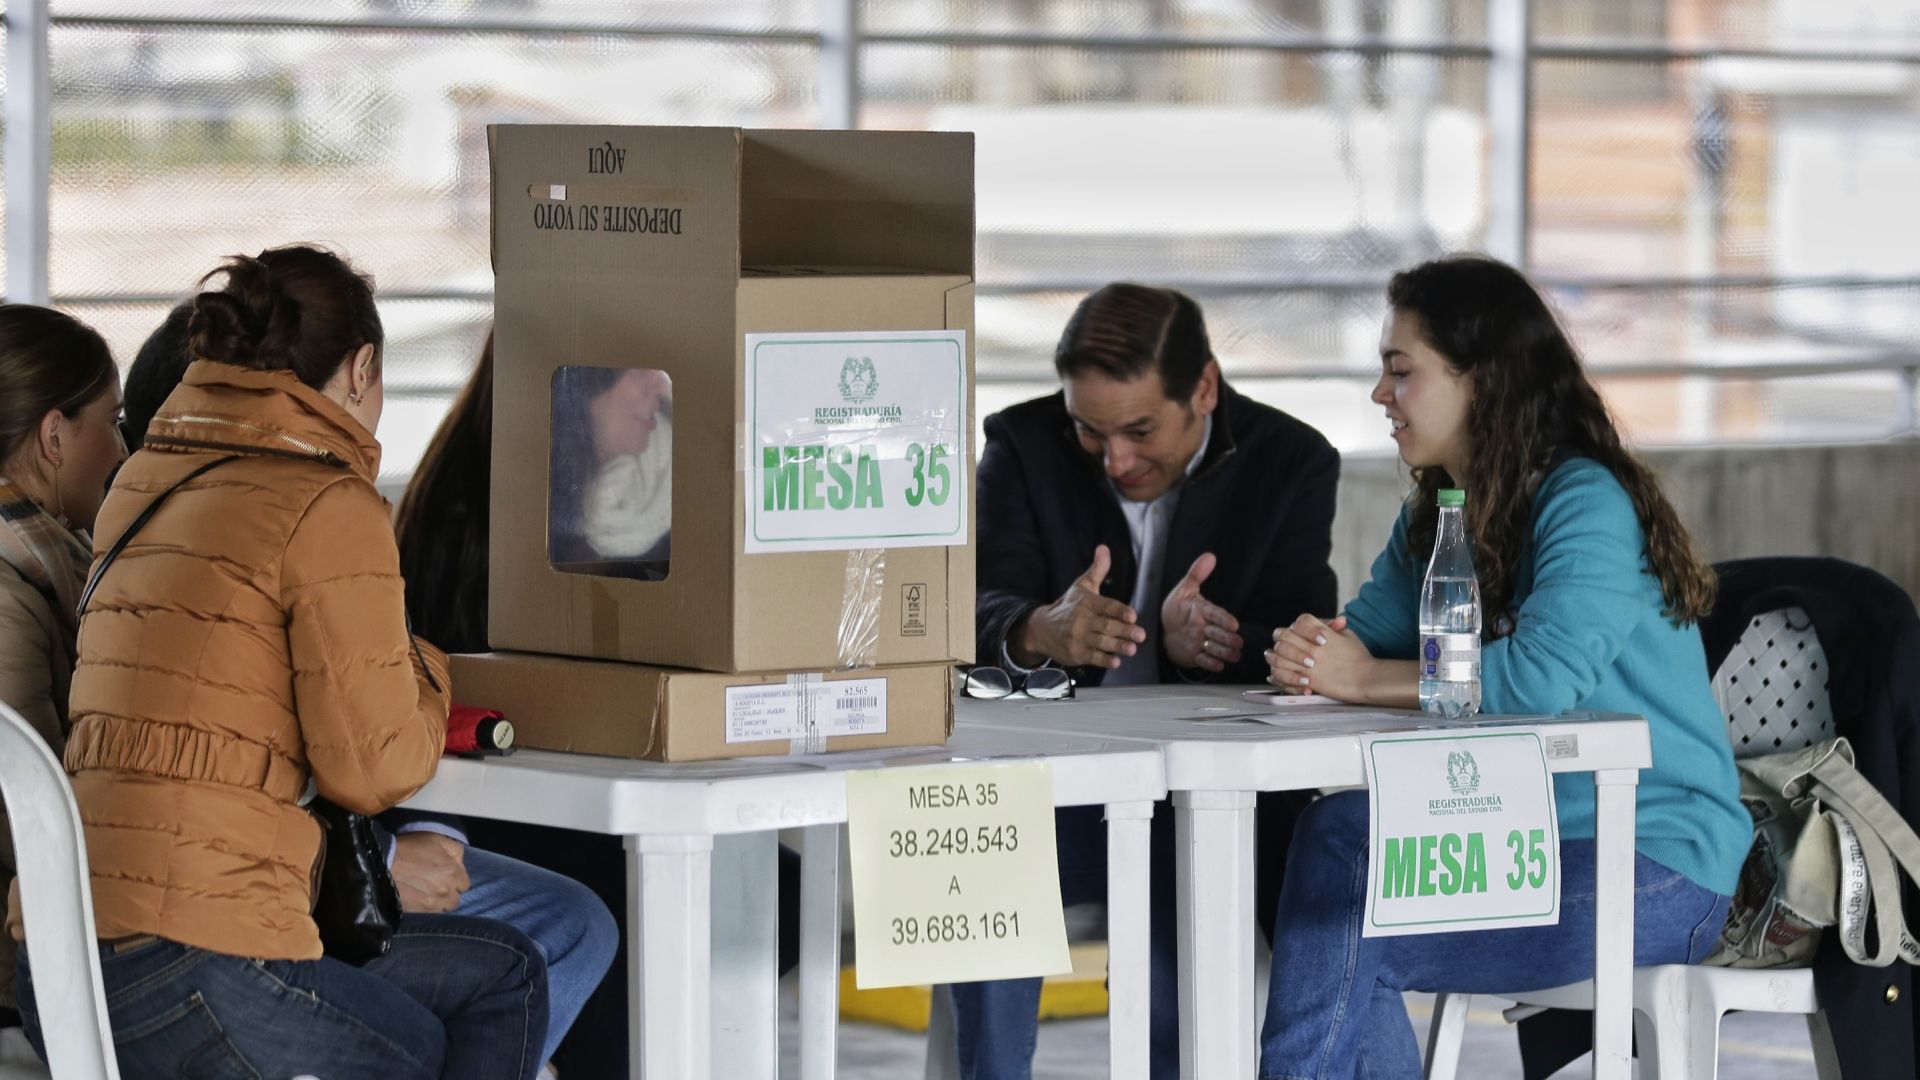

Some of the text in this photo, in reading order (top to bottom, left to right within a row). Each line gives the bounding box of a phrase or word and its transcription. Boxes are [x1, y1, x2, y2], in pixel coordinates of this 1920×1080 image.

[588, 141, 626, 174] AQUI
[534, 203, 682, 234] DEPOSITE SU VOTO
[815, 403, 902, 417] REGISTRADURÍA
[763, 443, 951, 512] MESA 35
[844, 687, 868, 697] 82.565
[909, 783, 999, 809] MESA 35
[1428, 794, 1502, 809] REGISTRADURÍA
[889, 824, 1019, 858] 38.249.543
[1382, 829, 1547, 899] MESA 35
[948, 875, 961, 895] A
[891, 911, 1020, 945] 39.683.161
